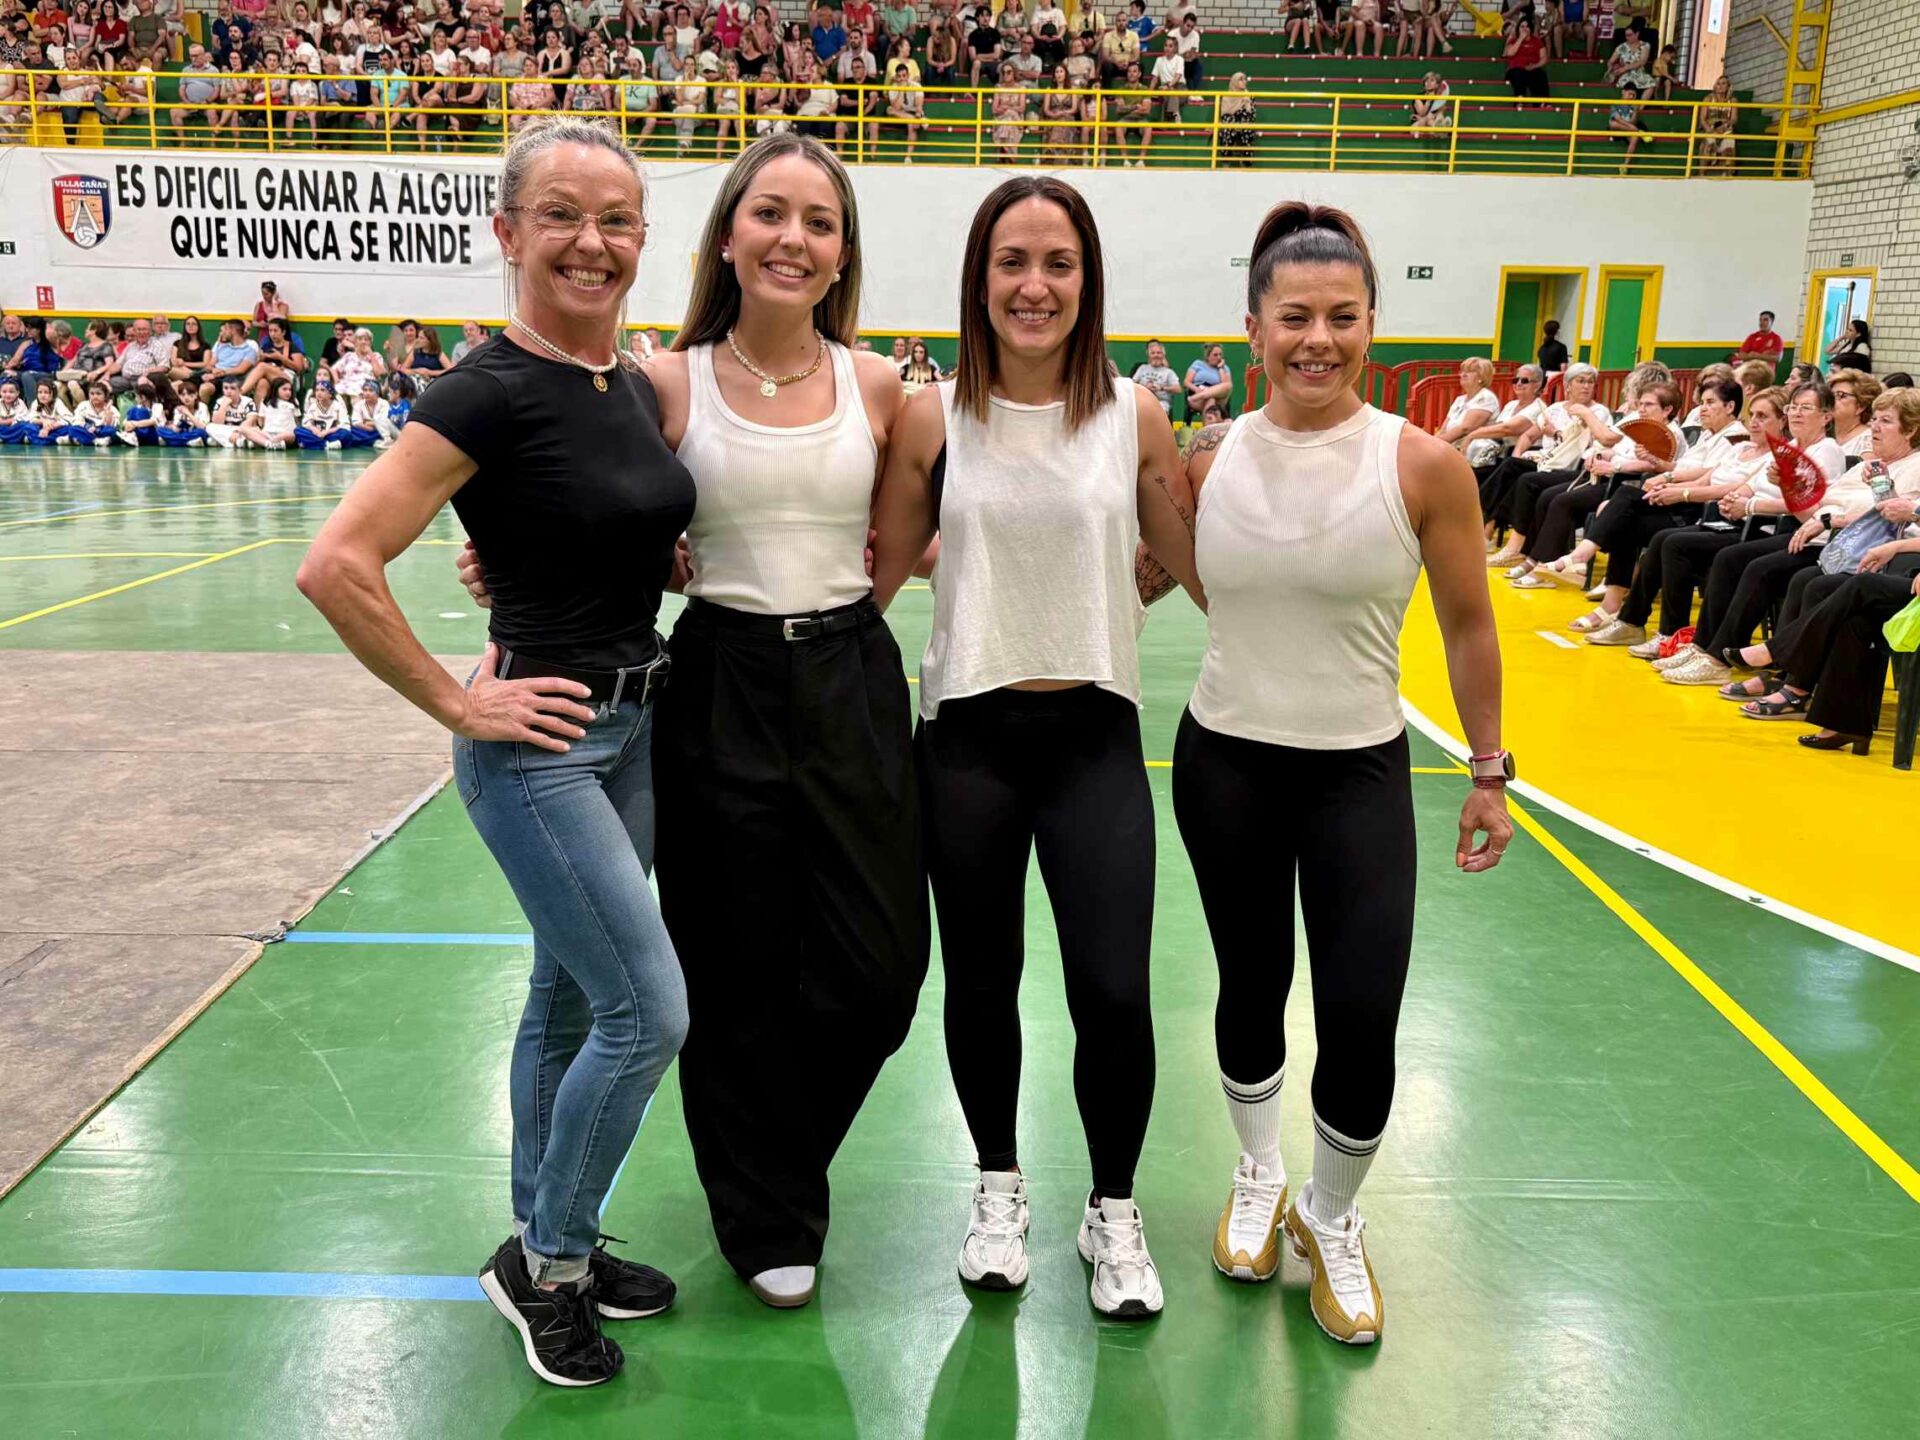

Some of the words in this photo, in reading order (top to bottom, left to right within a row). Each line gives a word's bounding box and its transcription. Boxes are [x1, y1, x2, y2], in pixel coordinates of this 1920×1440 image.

[54, 180, 108, 189] VILLACAÑAS
[115, 164, 146, 208] ES
[154, 165, 248, 210] DIFICIL
[255, 167, 360, 212] GANAR
[368, 171, 389, 214] A
[397, 172, 502, 217] ALGUIE
[170, 215, 229, 259] QUE
[236, 217, 342, 261] NUNCA
[349, 220, 379, 263] SE
[388, 222, 472, 265] RINDE
